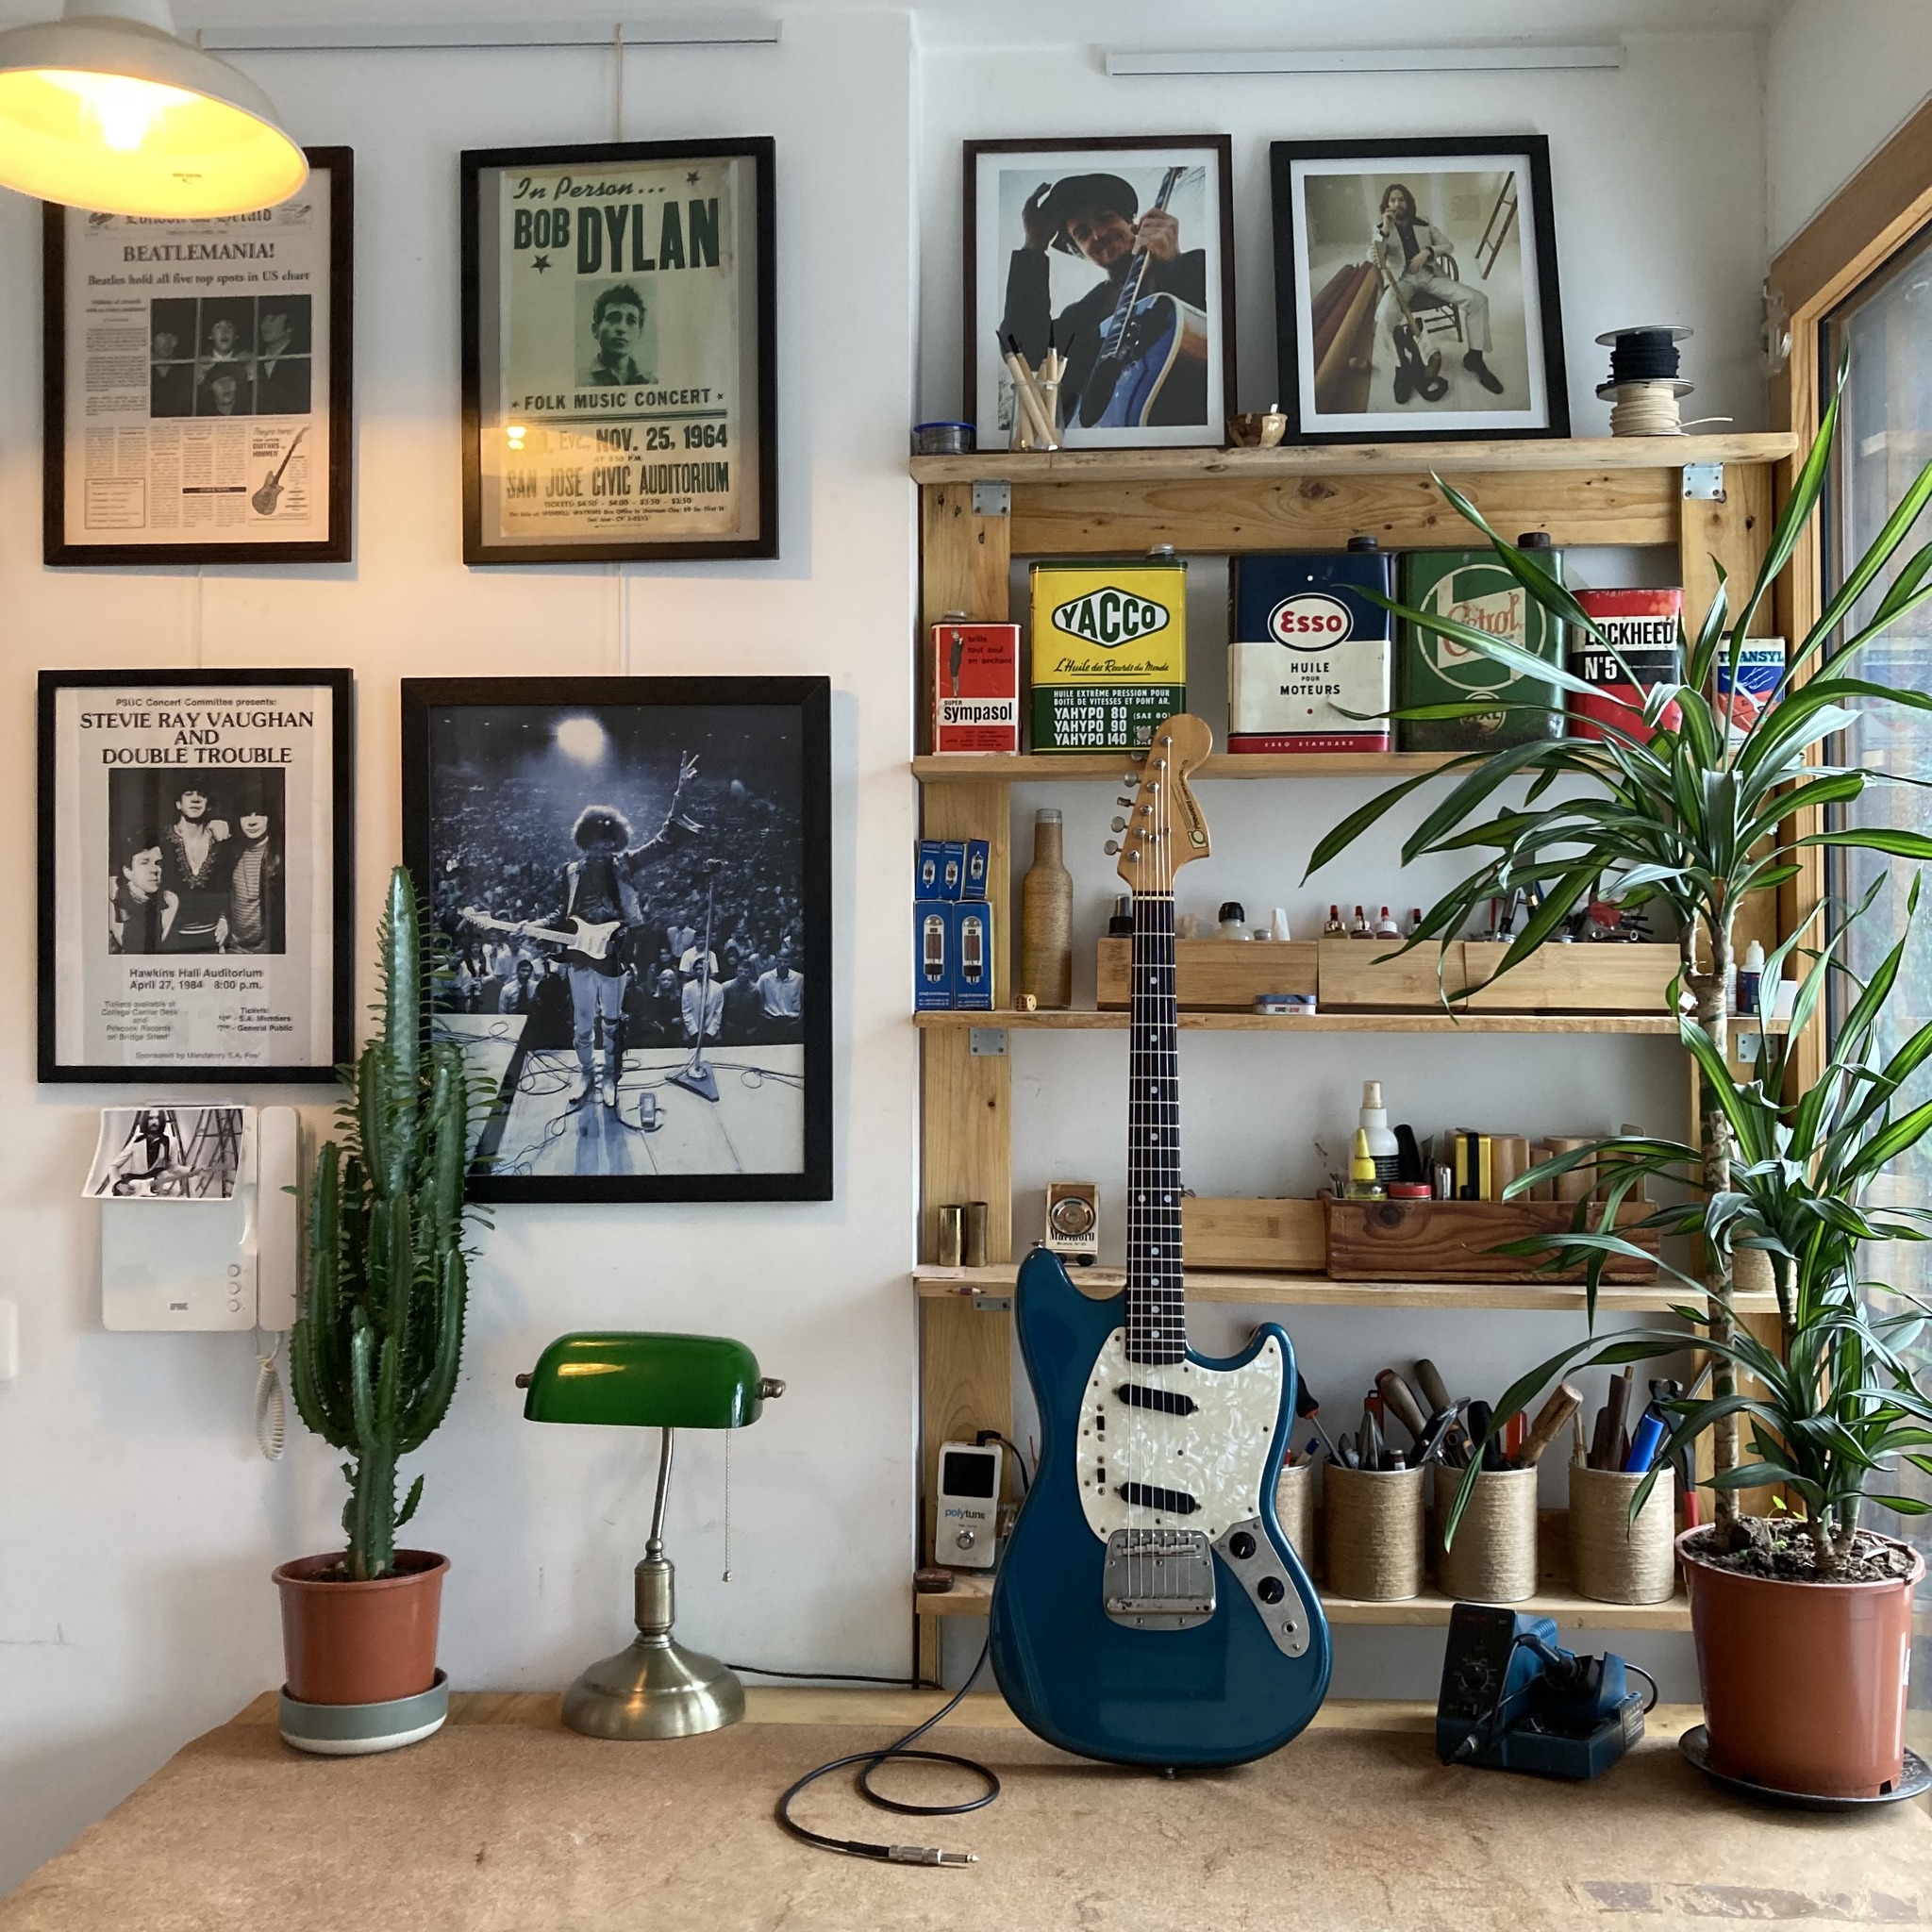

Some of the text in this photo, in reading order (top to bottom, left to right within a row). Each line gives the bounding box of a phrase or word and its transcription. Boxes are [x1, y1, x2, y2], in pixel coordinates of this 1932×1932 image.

[512, 177, 545, 200] In
[514, 197, 720, 275] BOB DYLAN
[123, 242, 275, 262] BEATLEMANIA!
[88, 271, 309, 286] Beatles hold all five top spots in US chart
[524, 389, 711, 410] FOLK MUSIC CONCERT
[596, 428, 639, 453] NOV.
[646, 426, 675, 451] 25,
[684, 424, 728, 449] 1964
[507, 461, 729, 499] SAN JOSE CIVIC AUDITORIUM
[1061, 592, 1157, 643] YACCO
[968, 635, 988, 643] brille
[1585, 622, 1674, 646] LOCKHEED
[1718, 651, 1784, 662] TANSYL
[1091, 662, 1103, 673] des
[1134, 663, 1143, 672] du
[1291, 662, 1329, 674] HUILE
[1054, 690, 1074, 698] HUILE
[1280, 685, 1341, 695] MOTEURS
[116, 697, 276, 708] PSUC Concert Committee presents:
[80, 711, 313, 729] STEVIE RAY VAUGHAN
[943, 702, 1013, 724] sympasol
[1054, 708, 1104, 721] YAHYPO
[1110, 708, 1127, 720] 80
[1054, 720, 1104, 733] YAHYPO
[1110, 720, 1127, 732] 90
[174, 729, 220, 745] AND
[1054, 733, 1104, 746] YAHYPO
[1108, 733, 1127, 745] 140
[102, 747, 292, 765] DOUBLE TROUBLE
[129, 968, 263, 978] Hawkins Hall Auditorium
[129, 980, 263, 991] April 27, 1984 8:00 p.m.
[944, 1508, 987, 1521] polytune
